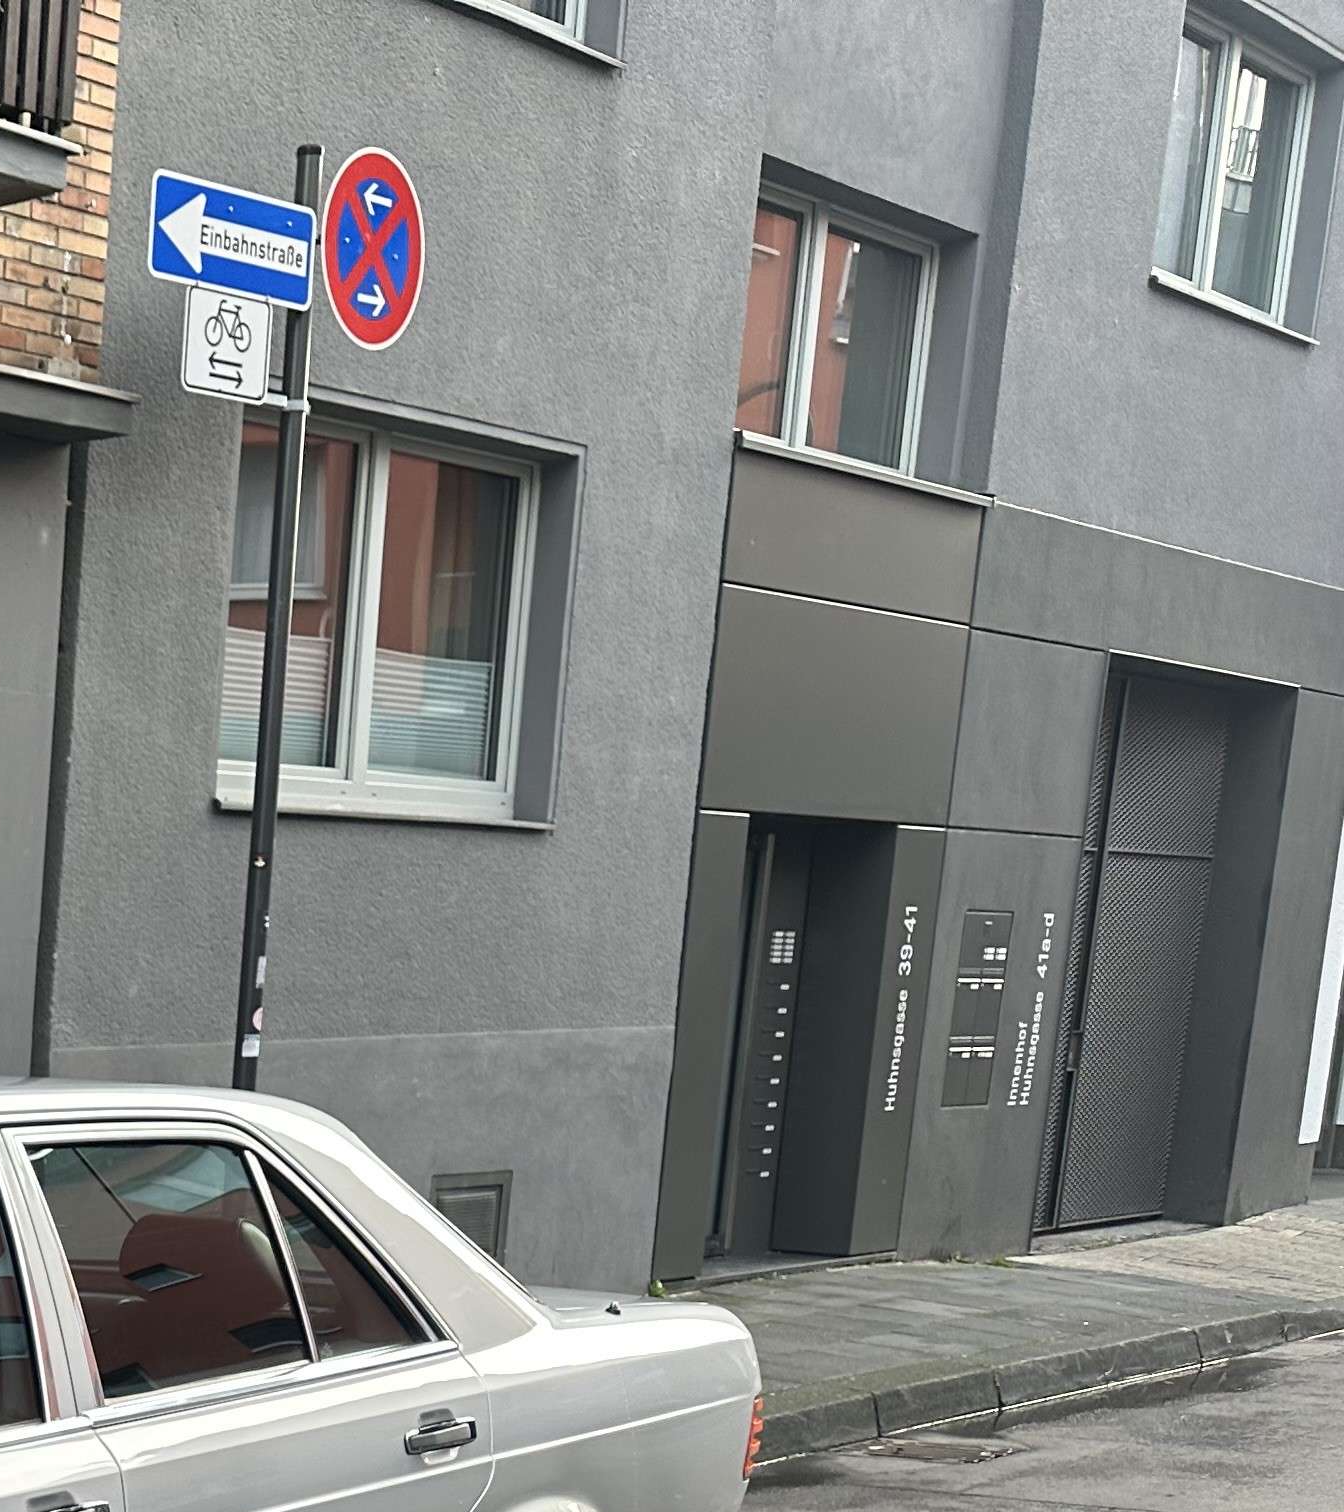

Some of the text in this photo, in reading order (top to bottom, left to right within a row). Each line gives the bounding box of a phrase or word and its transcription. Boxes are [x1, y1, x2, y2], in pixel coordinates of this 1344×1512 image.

[200, 223, 303, 268] Einbahnstraße
[883, 905, 918, 1111] Huhnsgasse 39-41
[1006, 1021, 1028, 1106] Innenhof
[1019, 912, 1055, 1106] Huhnsgasse 41a-d
